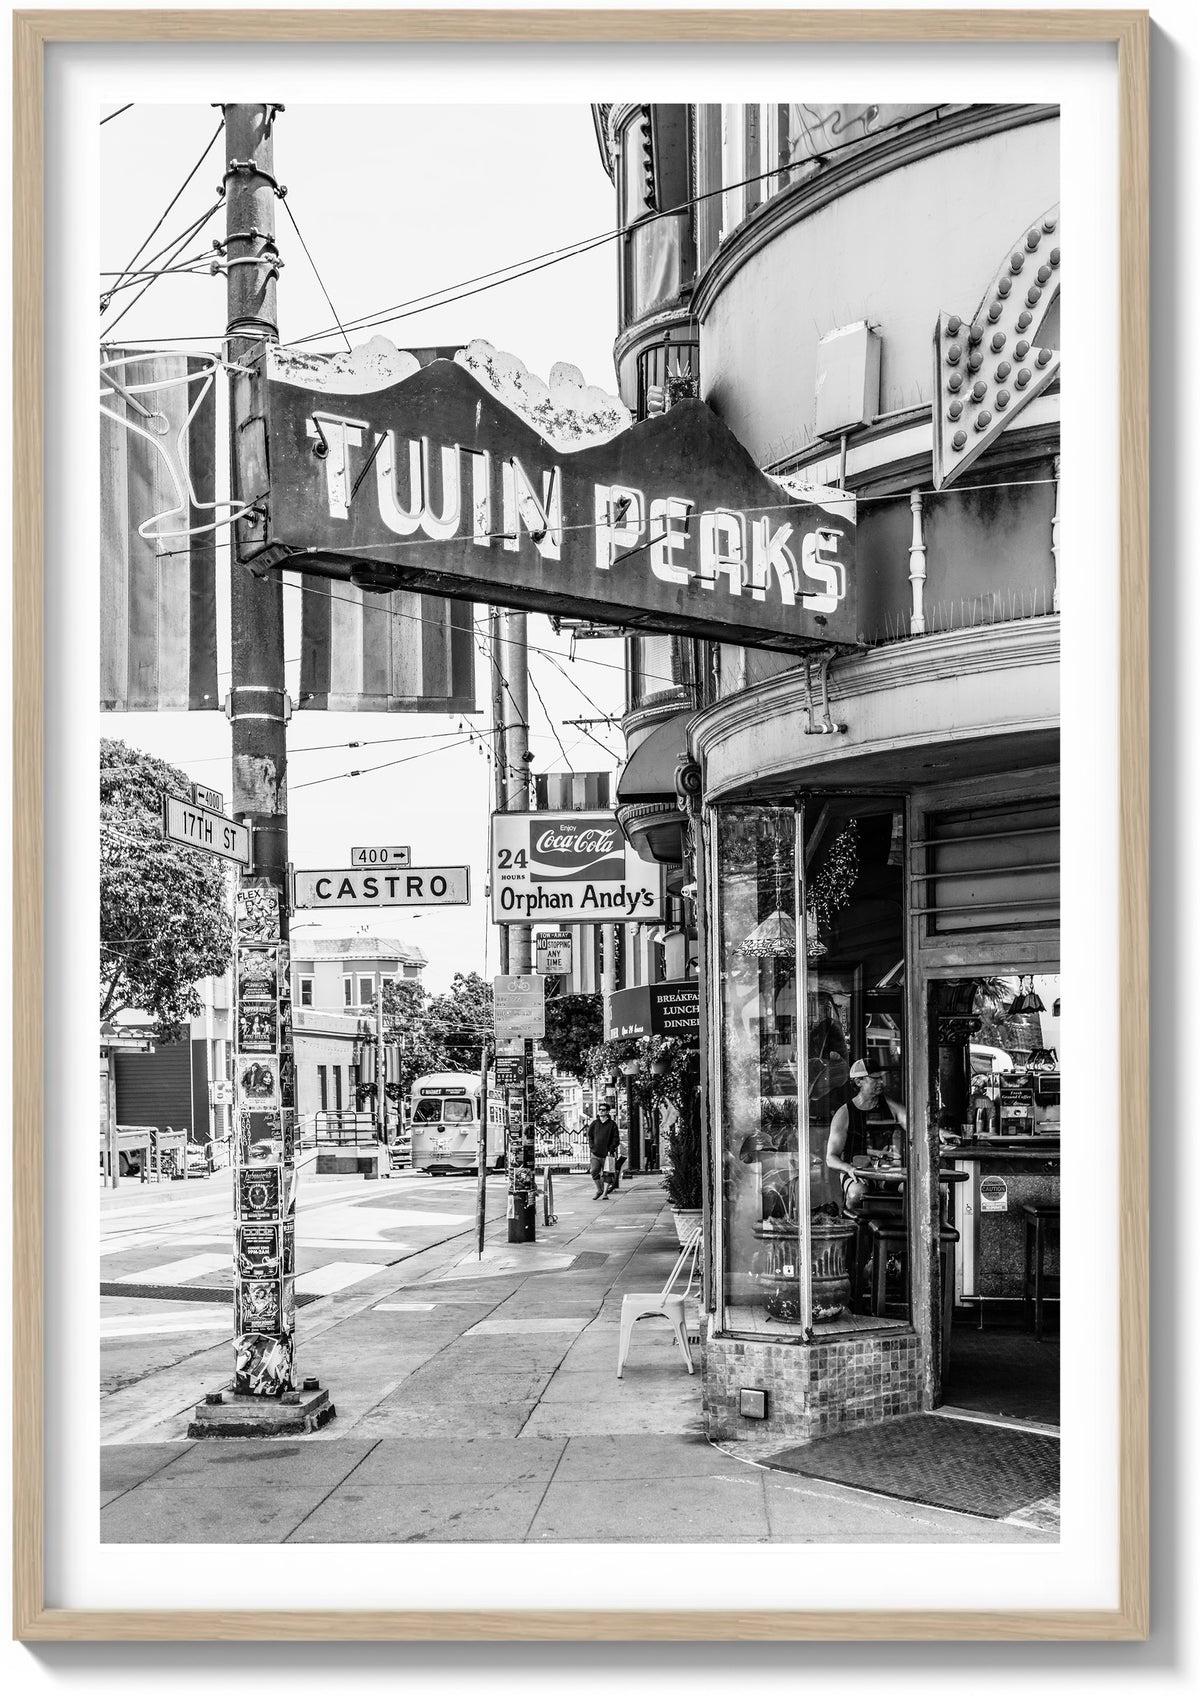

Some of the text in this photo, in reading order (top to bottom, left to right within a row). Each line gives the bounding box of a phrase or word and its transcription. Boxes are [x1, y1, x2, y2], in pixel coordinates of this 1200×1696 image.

[306, 411, 847, 614] TWIN PEAKS
[205, 791, 220, 809] 4000
[183, 811, 237, 851] 17TH ST
[559, 824, 577, 832] Enjoy
[535, 828, 617, 854] Coca-Cola
[358, 849, 388, 863] 400
[497, 848, 528, 870] 24
[315, 875, 447, 899] CASTRO
[237, 889, 261, 902] FLEX
[500, 884, 655, 917] Orphan Andy's
[537, 939, 571, 949] NO STOPPING
[546, 958, 562, 966] TIME
[547, 950, 561, 958] ANY
[663, 1005, 700, 1015] LUNCH
